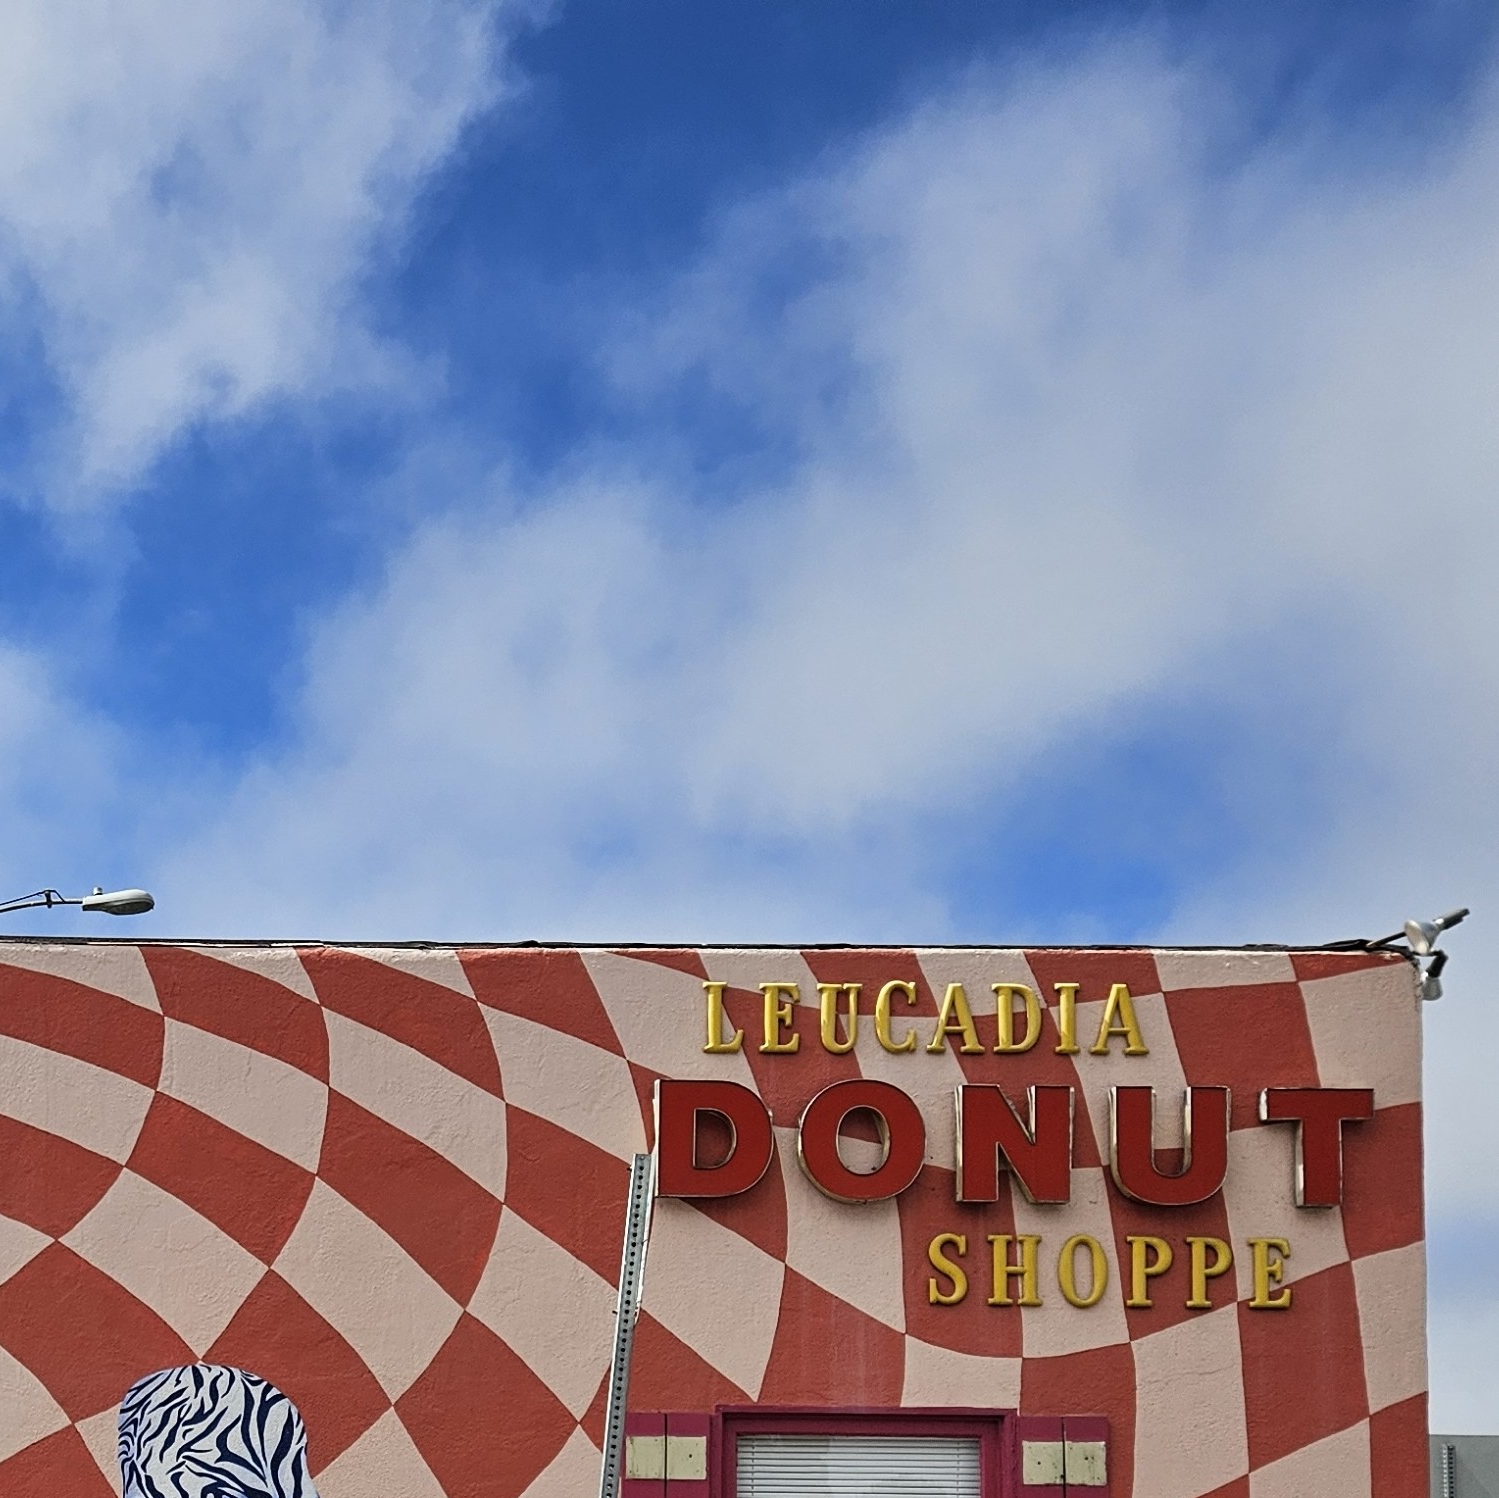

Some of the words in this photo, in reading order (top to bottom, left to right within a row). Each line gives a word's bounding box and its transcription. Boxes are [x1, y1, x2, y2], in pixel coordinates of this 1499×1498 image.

[702, 980, 1150, 1056] LEUCADIA
[653, 1079, 1375, 1208] DONUT
[928, 1232, 1292, 1310] SHOPPE
